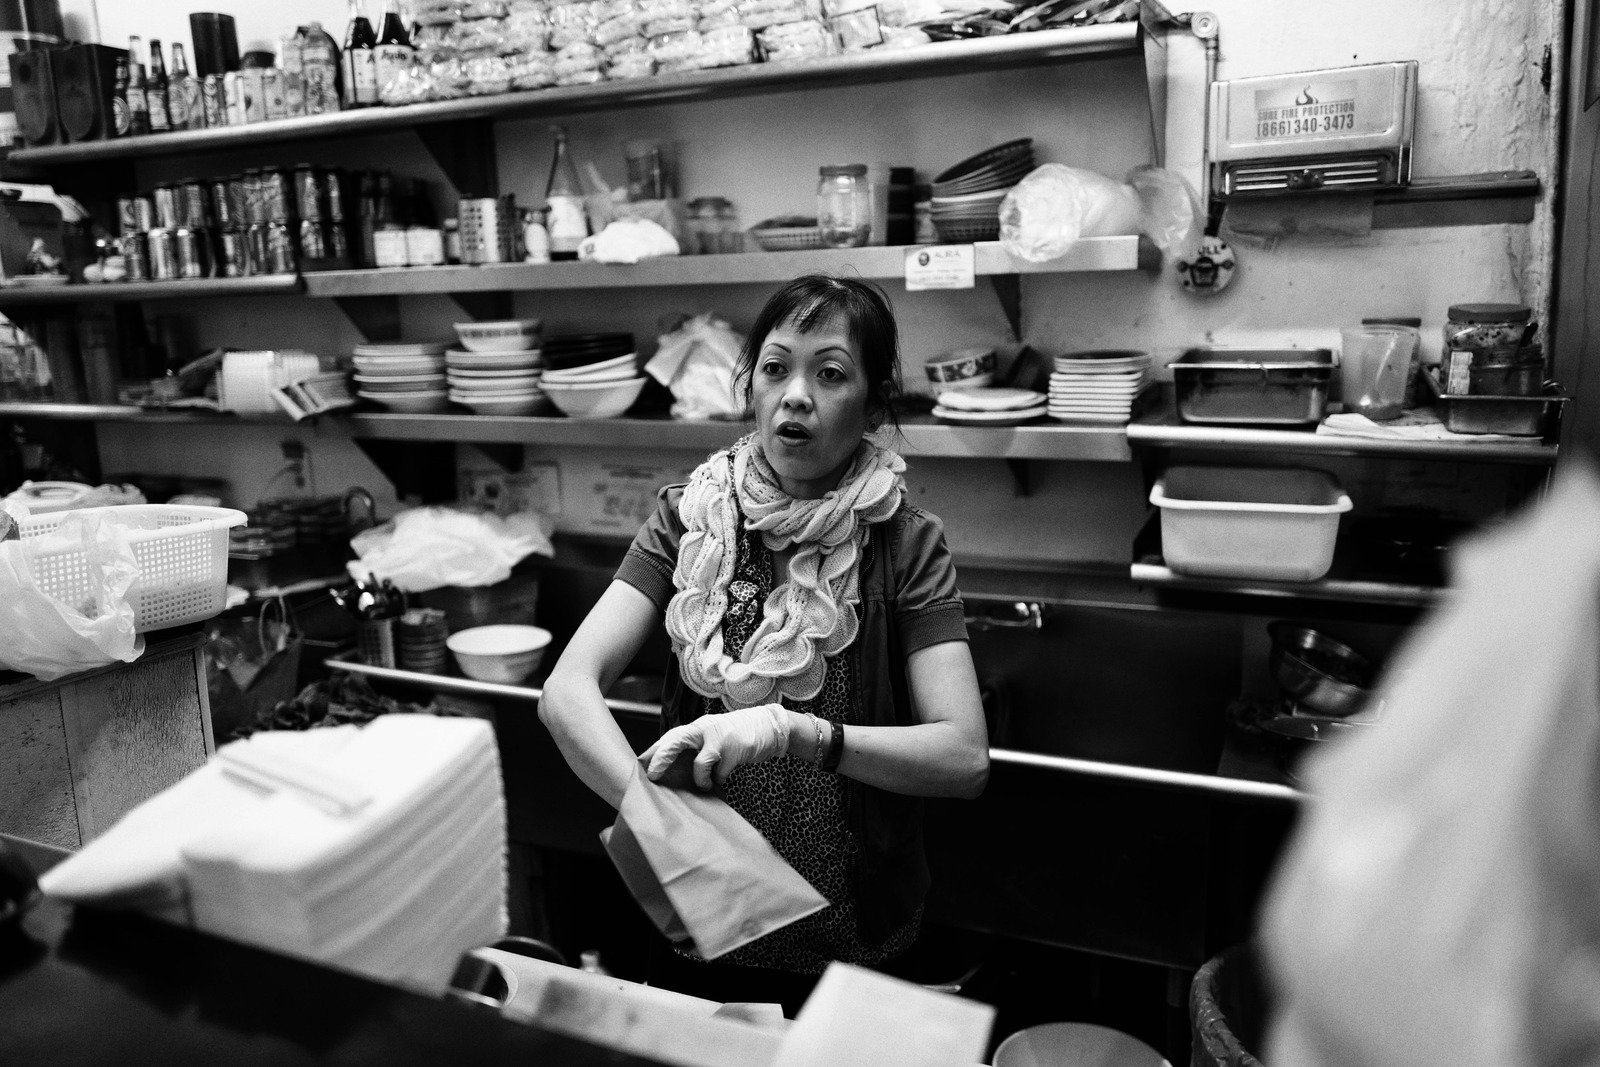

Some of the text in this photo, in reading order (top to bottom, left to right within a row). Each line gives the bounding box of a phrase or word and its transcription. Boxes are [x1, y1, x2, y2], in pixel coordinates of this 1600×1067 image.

[1257, 102, 1355, 121] SURE FIRE PROTECTION
[1257, 113, 1354, 137] (866) 340-3473
